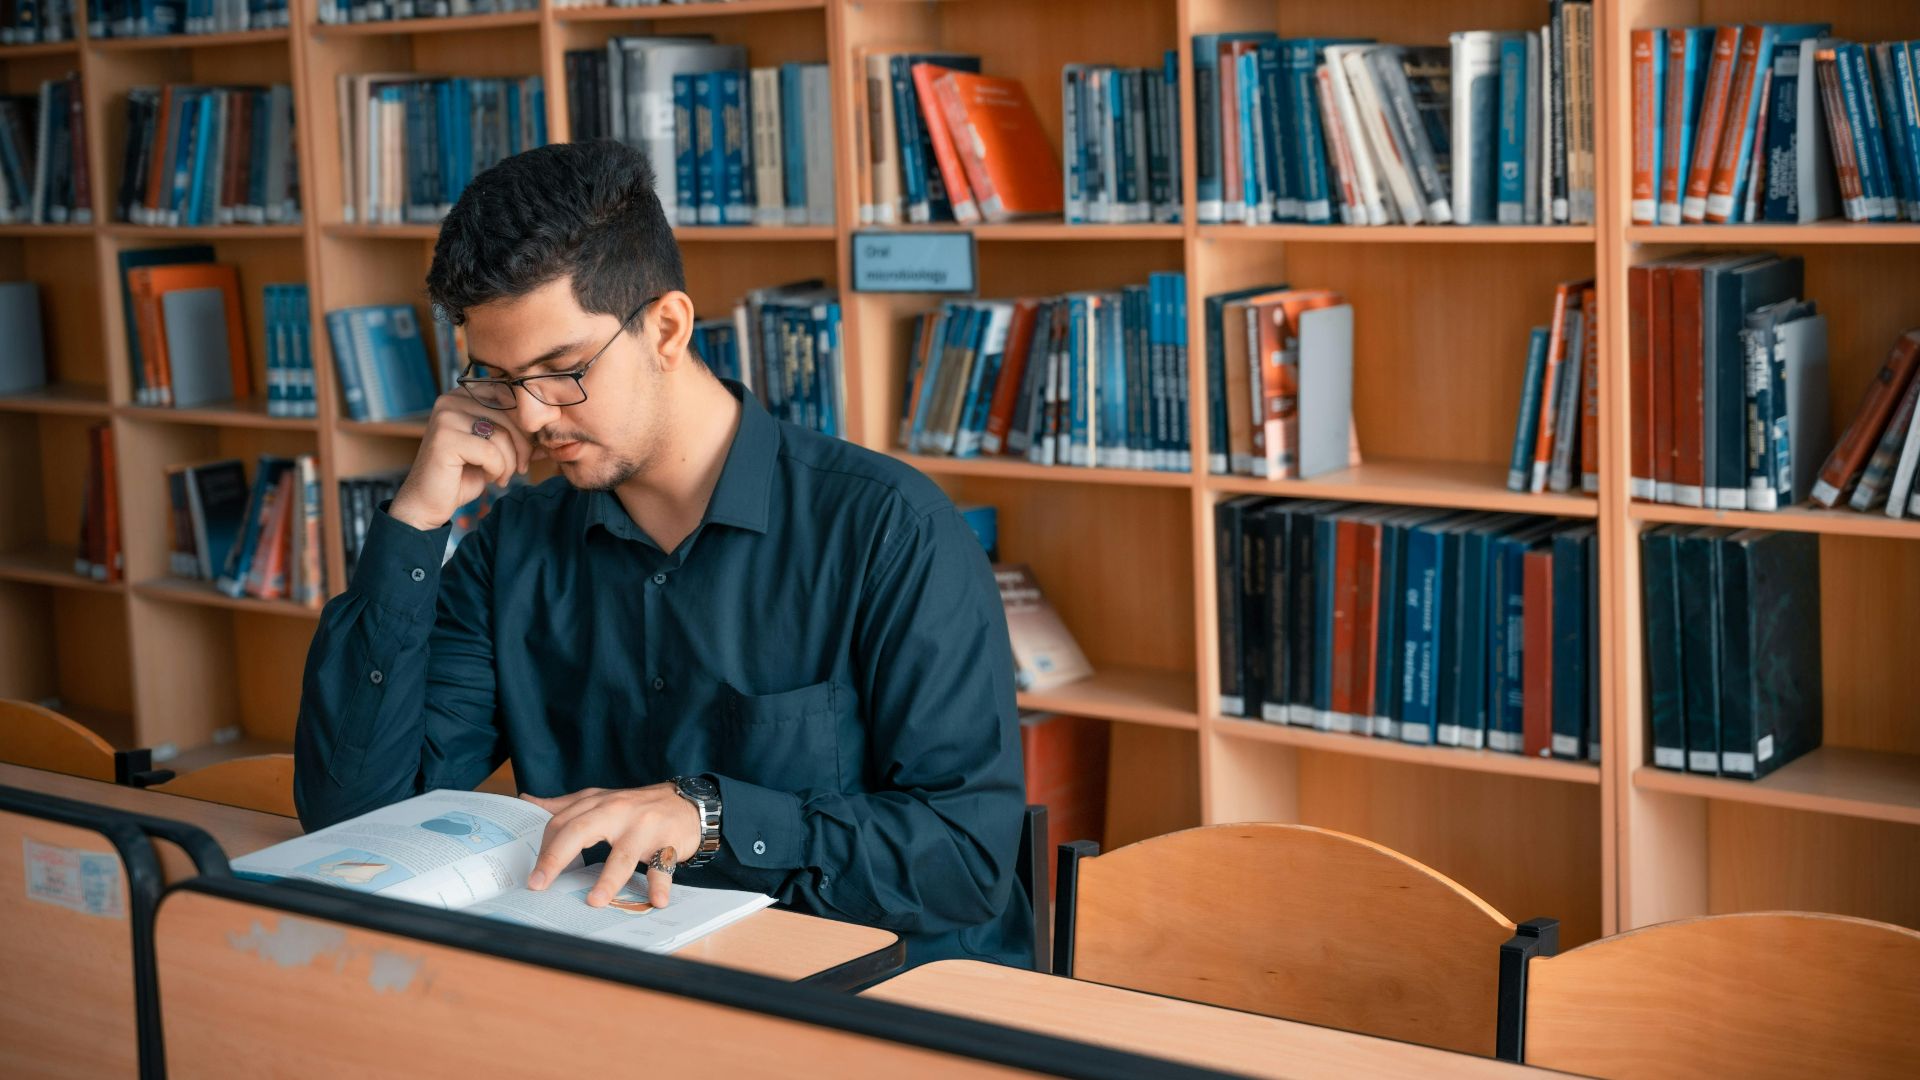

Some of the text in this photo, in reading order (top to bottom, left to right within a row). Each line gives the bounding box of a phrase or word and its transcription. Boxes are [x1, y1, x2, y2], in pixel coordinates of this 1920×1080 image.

[1770, 145, 1781, 200] CLINICAL
[865, 244, 890, 258] Oral
[866, 269, 948, 284] microbiology
